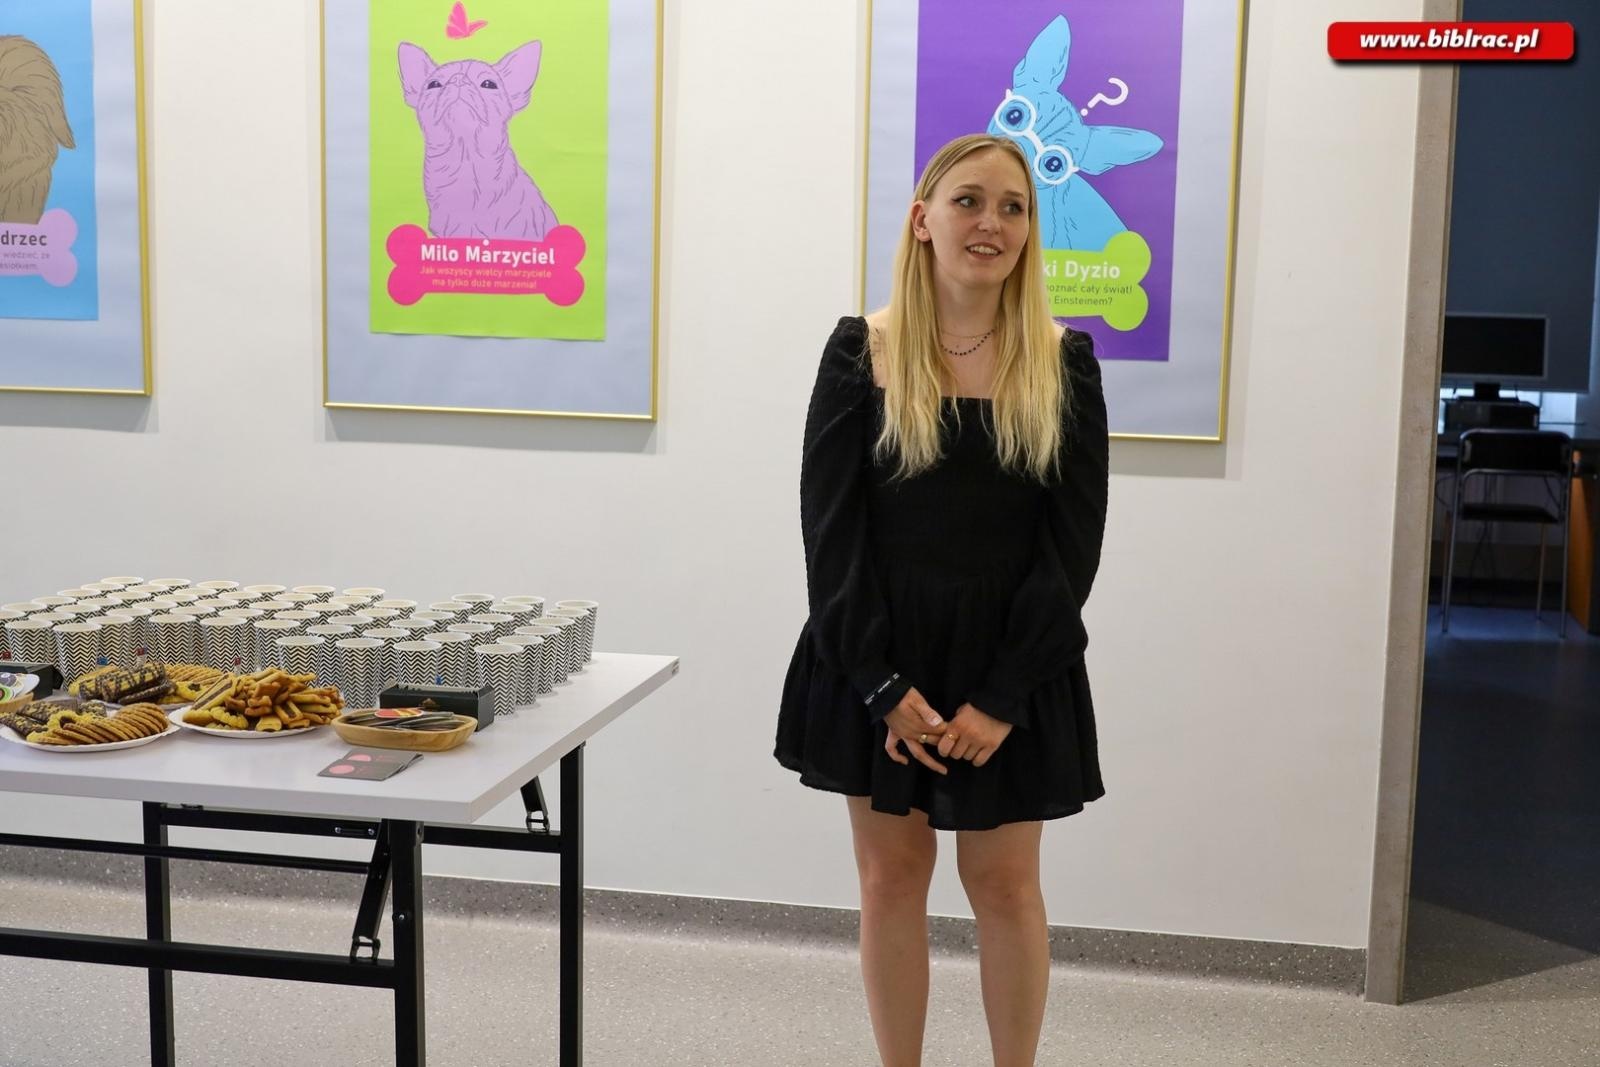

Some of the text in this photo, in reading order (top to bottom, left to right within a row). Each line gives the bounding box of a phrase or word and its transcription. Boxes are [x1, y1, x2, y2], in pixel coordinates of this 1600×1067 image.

[421, 243, 556, 268] Milo Marzyciel
[419, 266, 552, 279] Jak wszyscy wielcy marzyciele
[1065, 260, 1120, 282] Dyzio
[432, 278, 537, 289] ma tylko duże marzenia!
[1080, 284, 1101, 295] cały
[1103, 284, 1133, 295] świat!
[1054, 295, 1113, 306] Einsteinem?
